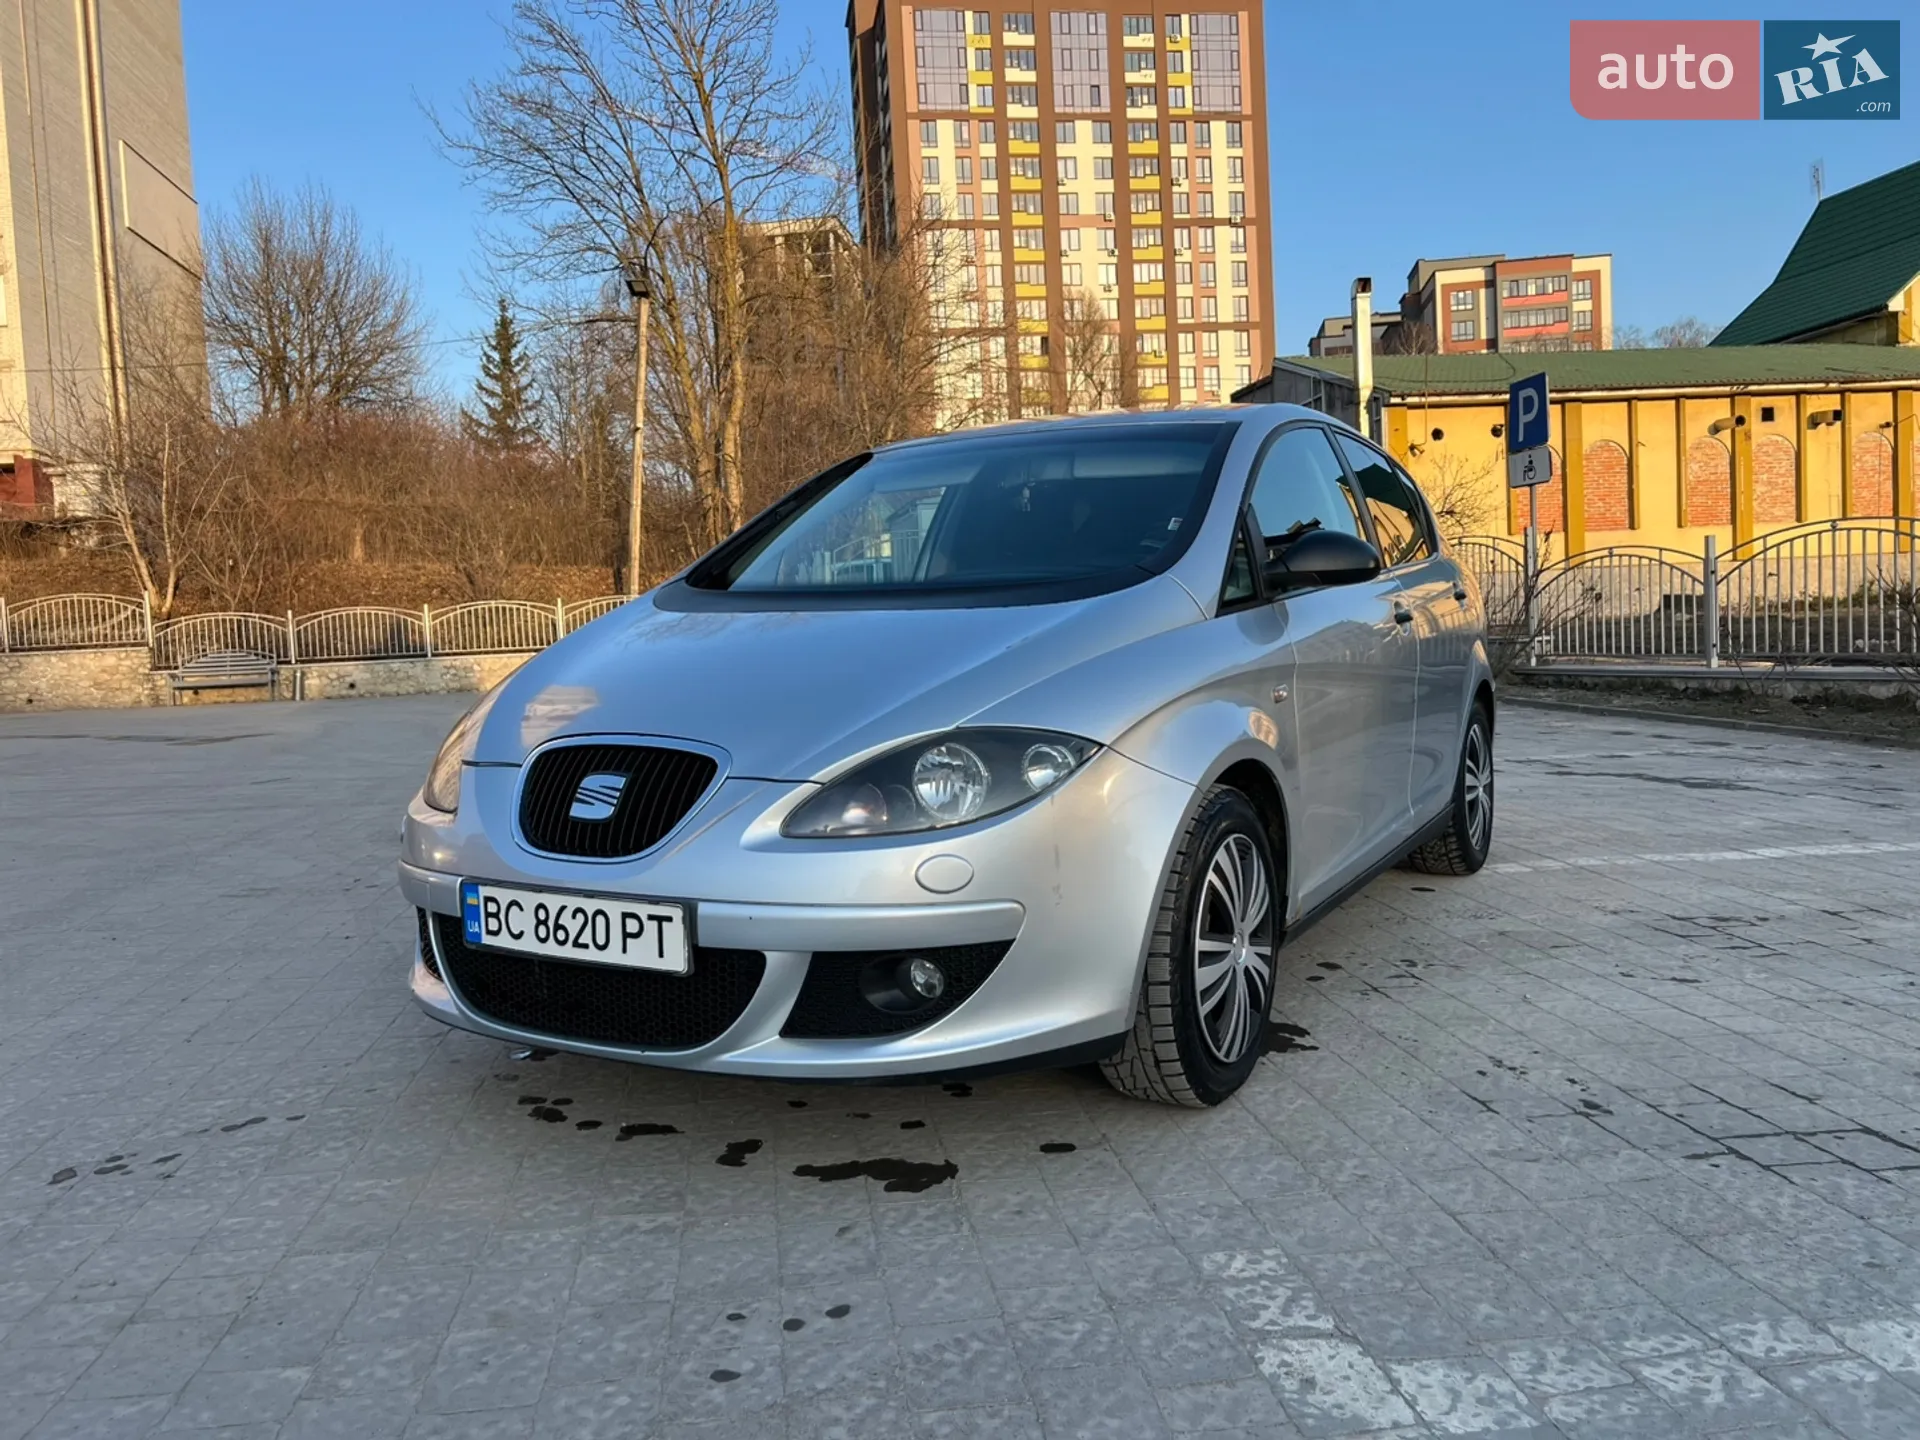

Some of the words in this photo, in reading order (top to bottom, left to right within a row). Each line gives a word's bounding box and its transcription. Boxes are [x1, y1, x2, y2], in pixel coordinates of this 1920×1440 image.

[1518, 387, 1539, 442] P
[467, 919, 480, 934] UA
[483, 895, 525, 941] BC
[533, 902, 611, 951] 8620
[621, 911, 673, 958] PT
